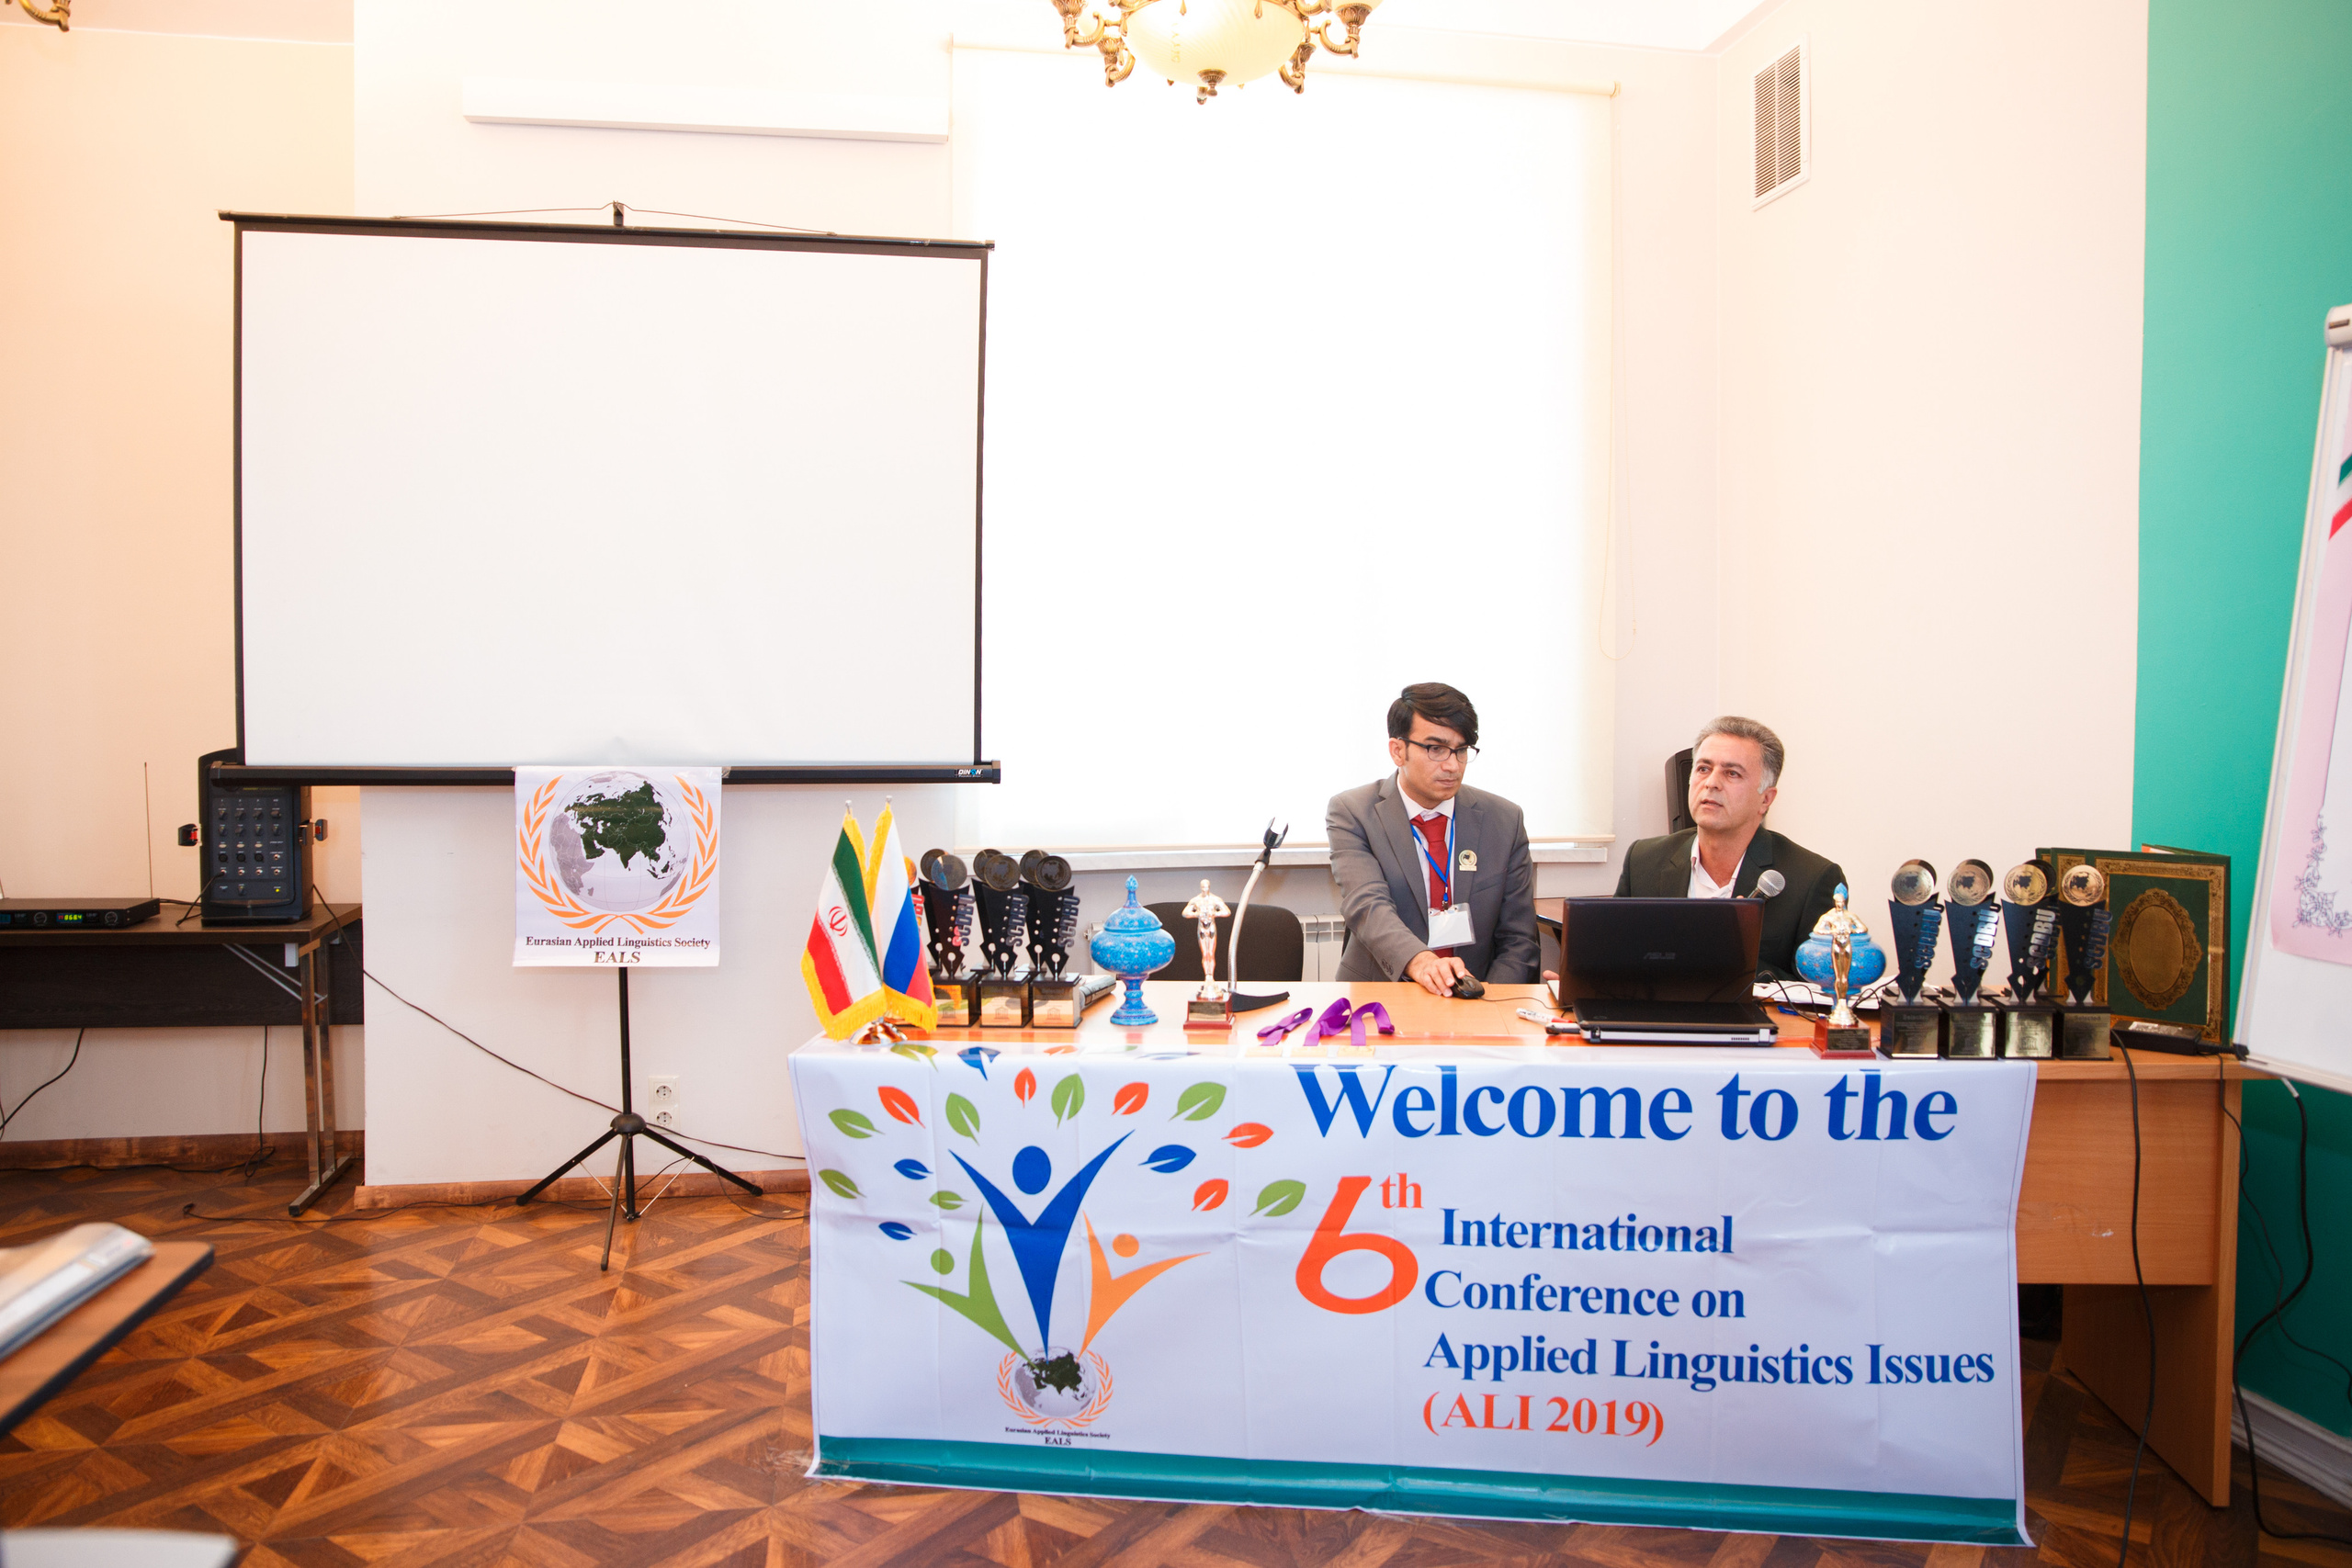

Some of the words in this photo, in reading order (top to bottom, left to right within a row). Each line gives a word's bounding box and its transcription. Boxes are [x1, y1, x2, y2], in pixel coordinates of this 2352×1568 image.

[526, 936, 571, 946] Eurasian
[574, 937, 614, 948] Applied
[617, 937, 672, 949] Linguistics
[674, 937, 710, 950] Society
[594, 951, 640, 964] EALS
[1289, 1064, 1692, 1141] Welcome
[1716, 1072, 1799, 1141] to
[1824, 1068, 1958, 1141] the
[1439, 1208, 1734, 1254] International
[1425, 1269, 1679, 1317] Conference
[1691, 1288, 1745, 1318] on
[1422, 1332, 1598, 1382] Applied
[1611, 1338, 1853, 1392] Linguistics
[1864, 1344, 1995, 1384] Issues
[1045, 1437, 1071, 1446] EALS
[1057, 1429, 1089, 1438] Linguistics
[1089, 1431, 1111, 1439] Society
[1423, 1392, 1533, 1436] (ALI
[1545, 1396, 1664, 1448] 2019)
